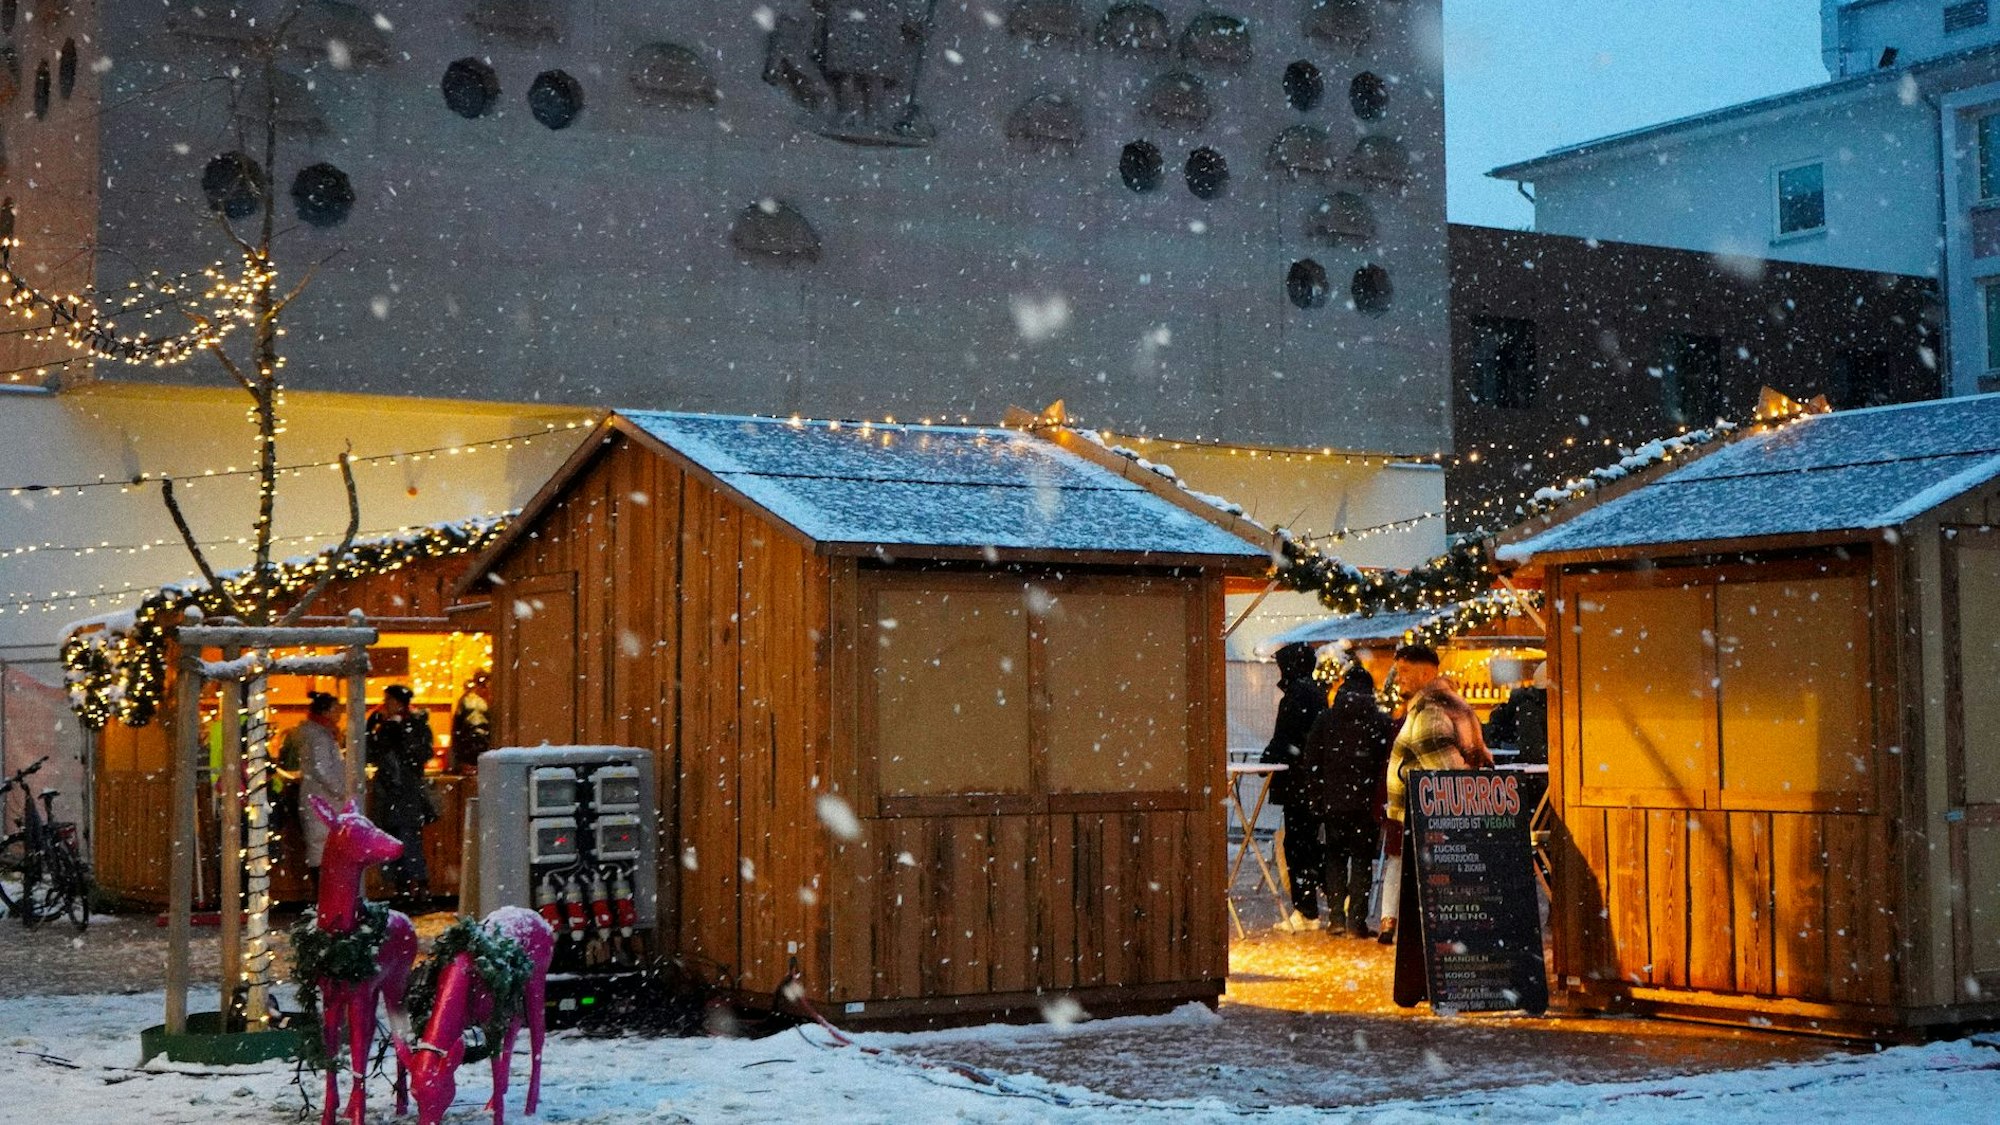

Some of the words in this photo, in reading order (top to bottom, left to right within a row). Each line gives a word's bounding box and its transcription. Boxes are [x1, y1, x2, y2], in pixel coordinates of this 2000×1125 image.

[1419, 775, 1521, 816] CHURROS
[1470, 817, 1482, 829] IST
[1484, 816, 1516, 829] VEGAN
[1433, 844, 1467, 853] ZUCKER
[1464, 863, 1487, 873] ZUCKER
[1445, 971, 1477, 979] KOKOS
